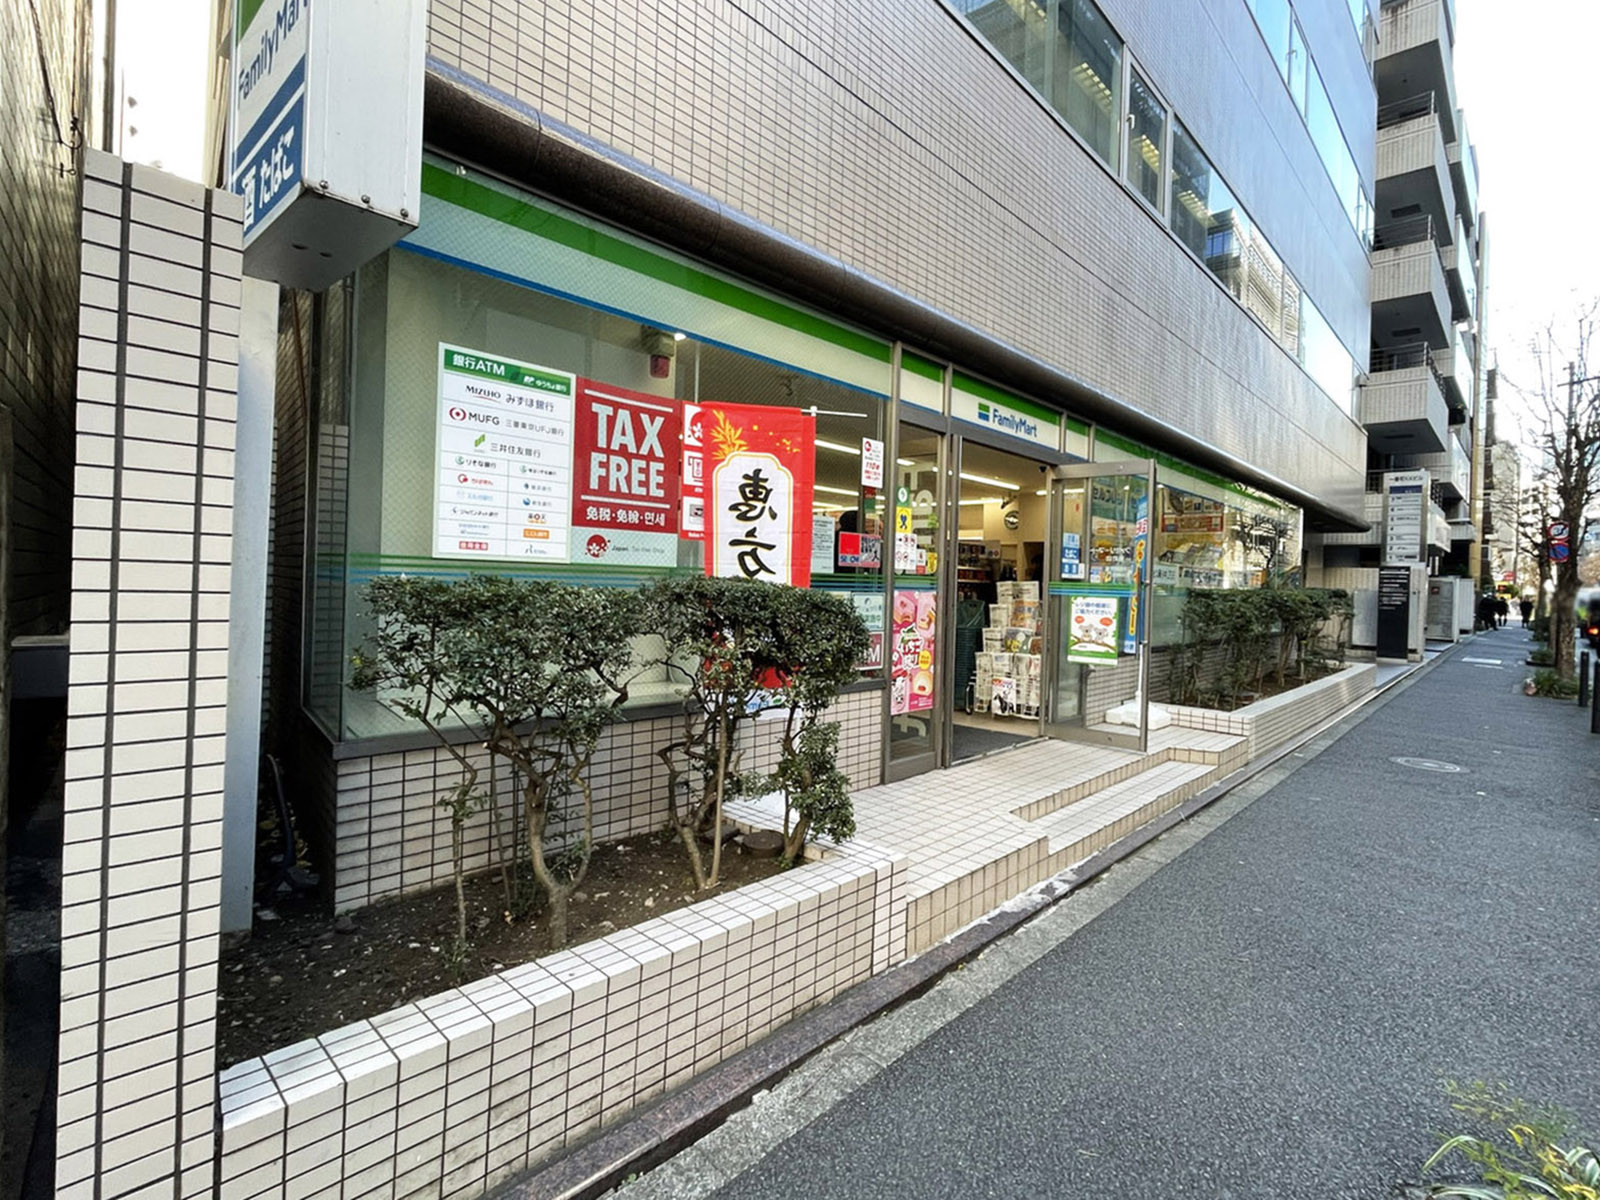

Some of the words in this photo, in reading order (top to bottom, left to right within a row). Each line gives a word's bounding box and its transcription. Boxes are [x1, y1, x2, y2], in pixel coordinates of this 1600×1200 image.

[238, 0, 308, 109] FamilyMar
[259, 126, 294, 209] たばこ
[452, 353, 505, 376] 銀行ATM
[465, 385, 501, 400] MIZUHO
[505, 393, 555, 413] みずほ銀行
[468, 411, 500, 426] MUFG
[591, 402, 665, 458] TAX
[992, 408, 1038, 438] FamilyMart
[490, 442, 542, 458] 三井住友銀行
[589, 451, 665, 498] FREE
